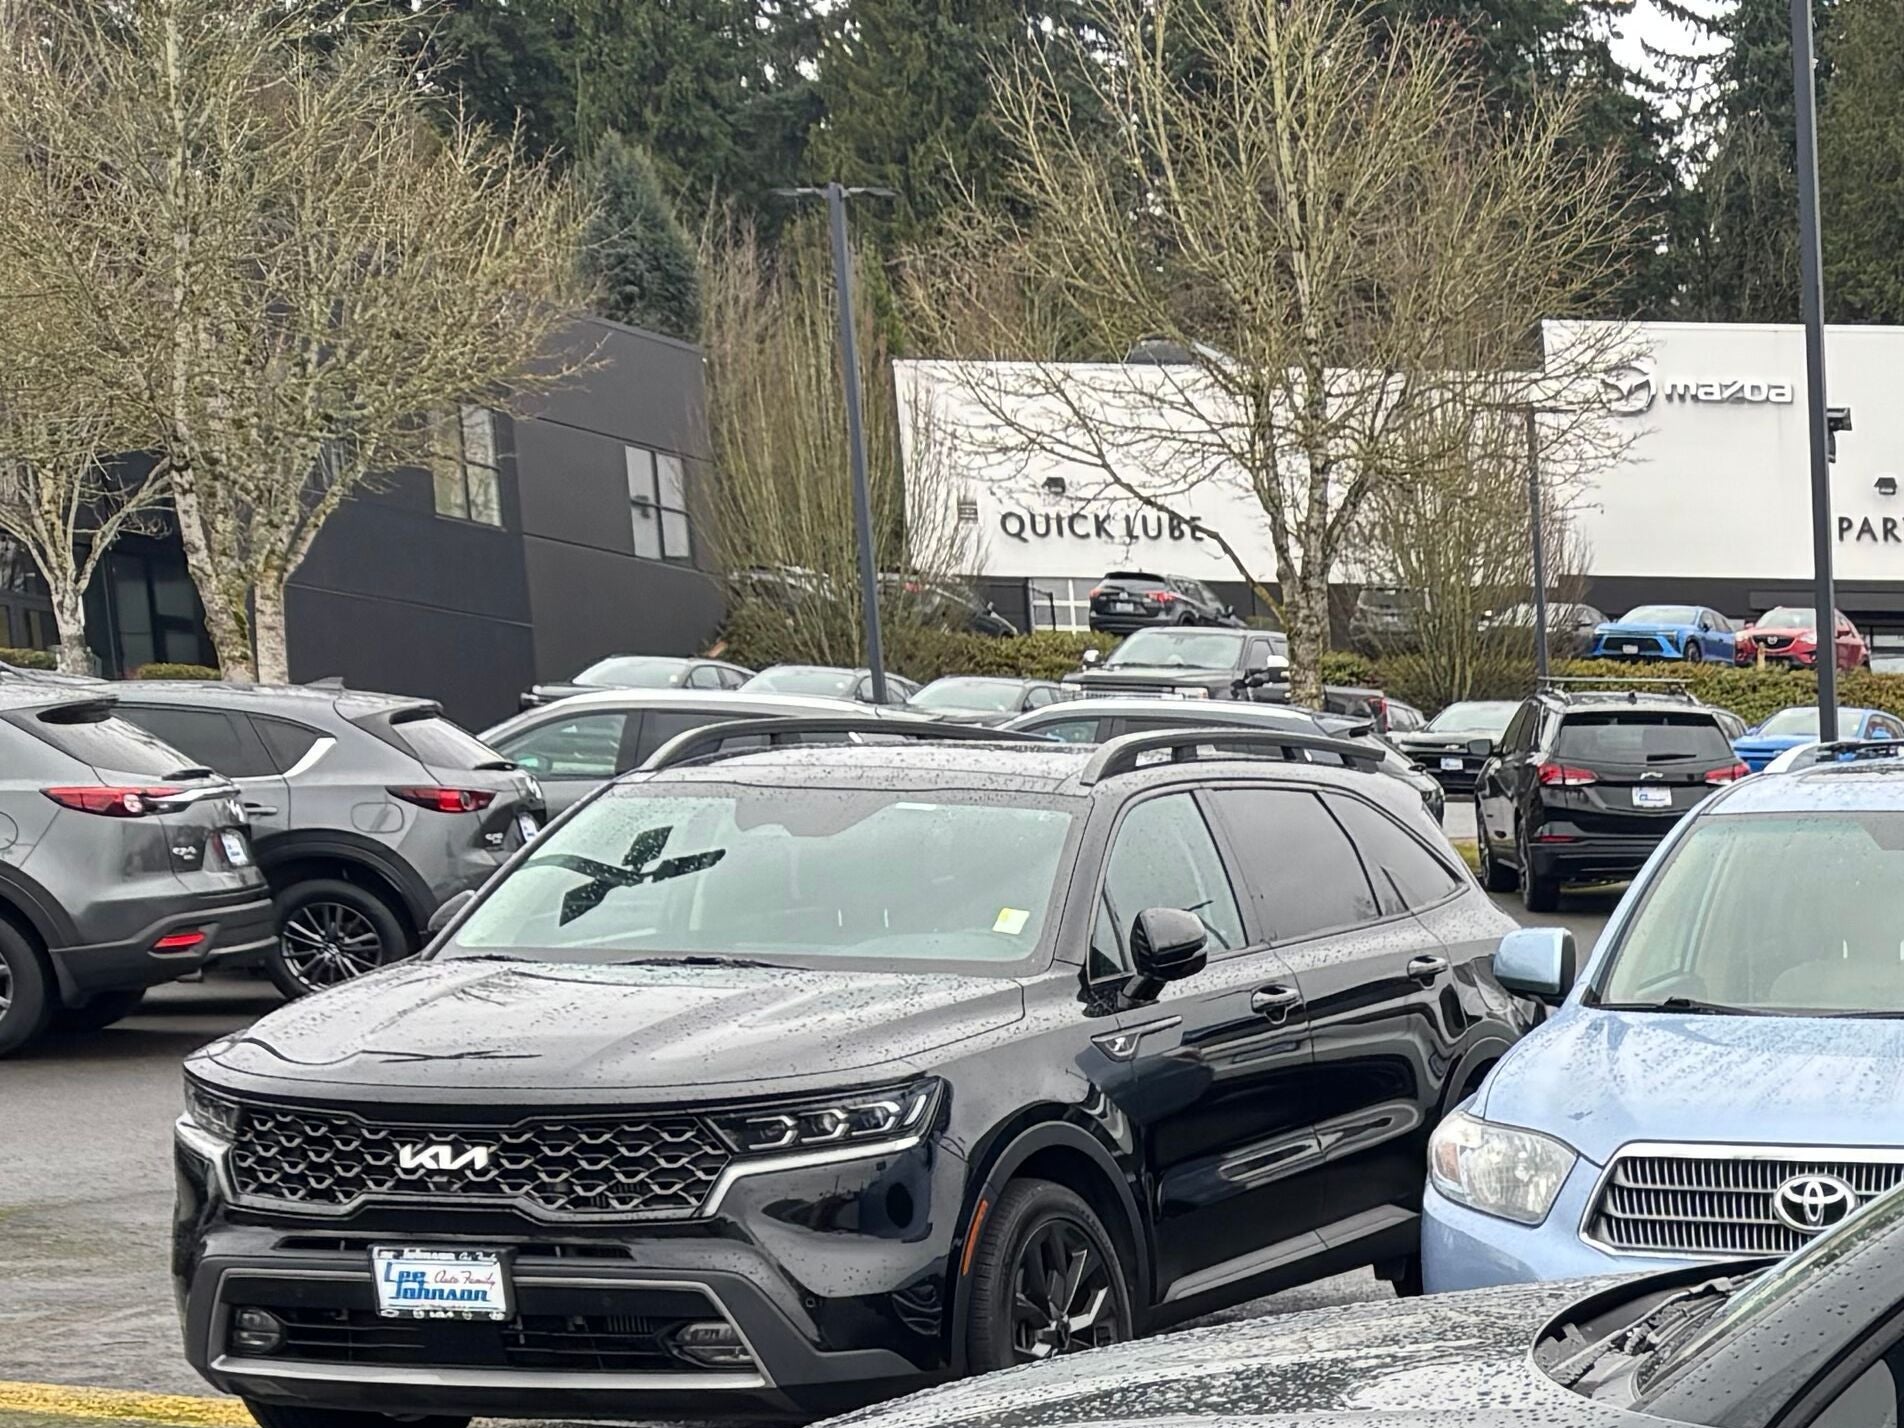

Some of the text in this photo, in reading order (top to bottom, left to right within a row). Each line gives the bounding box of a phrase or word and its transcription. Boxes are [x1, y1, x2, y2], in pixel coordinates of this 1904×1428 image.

[1000, 511, 1205, 543] QUICK LUBE
[400, 1144, 489, 1170] KIA
